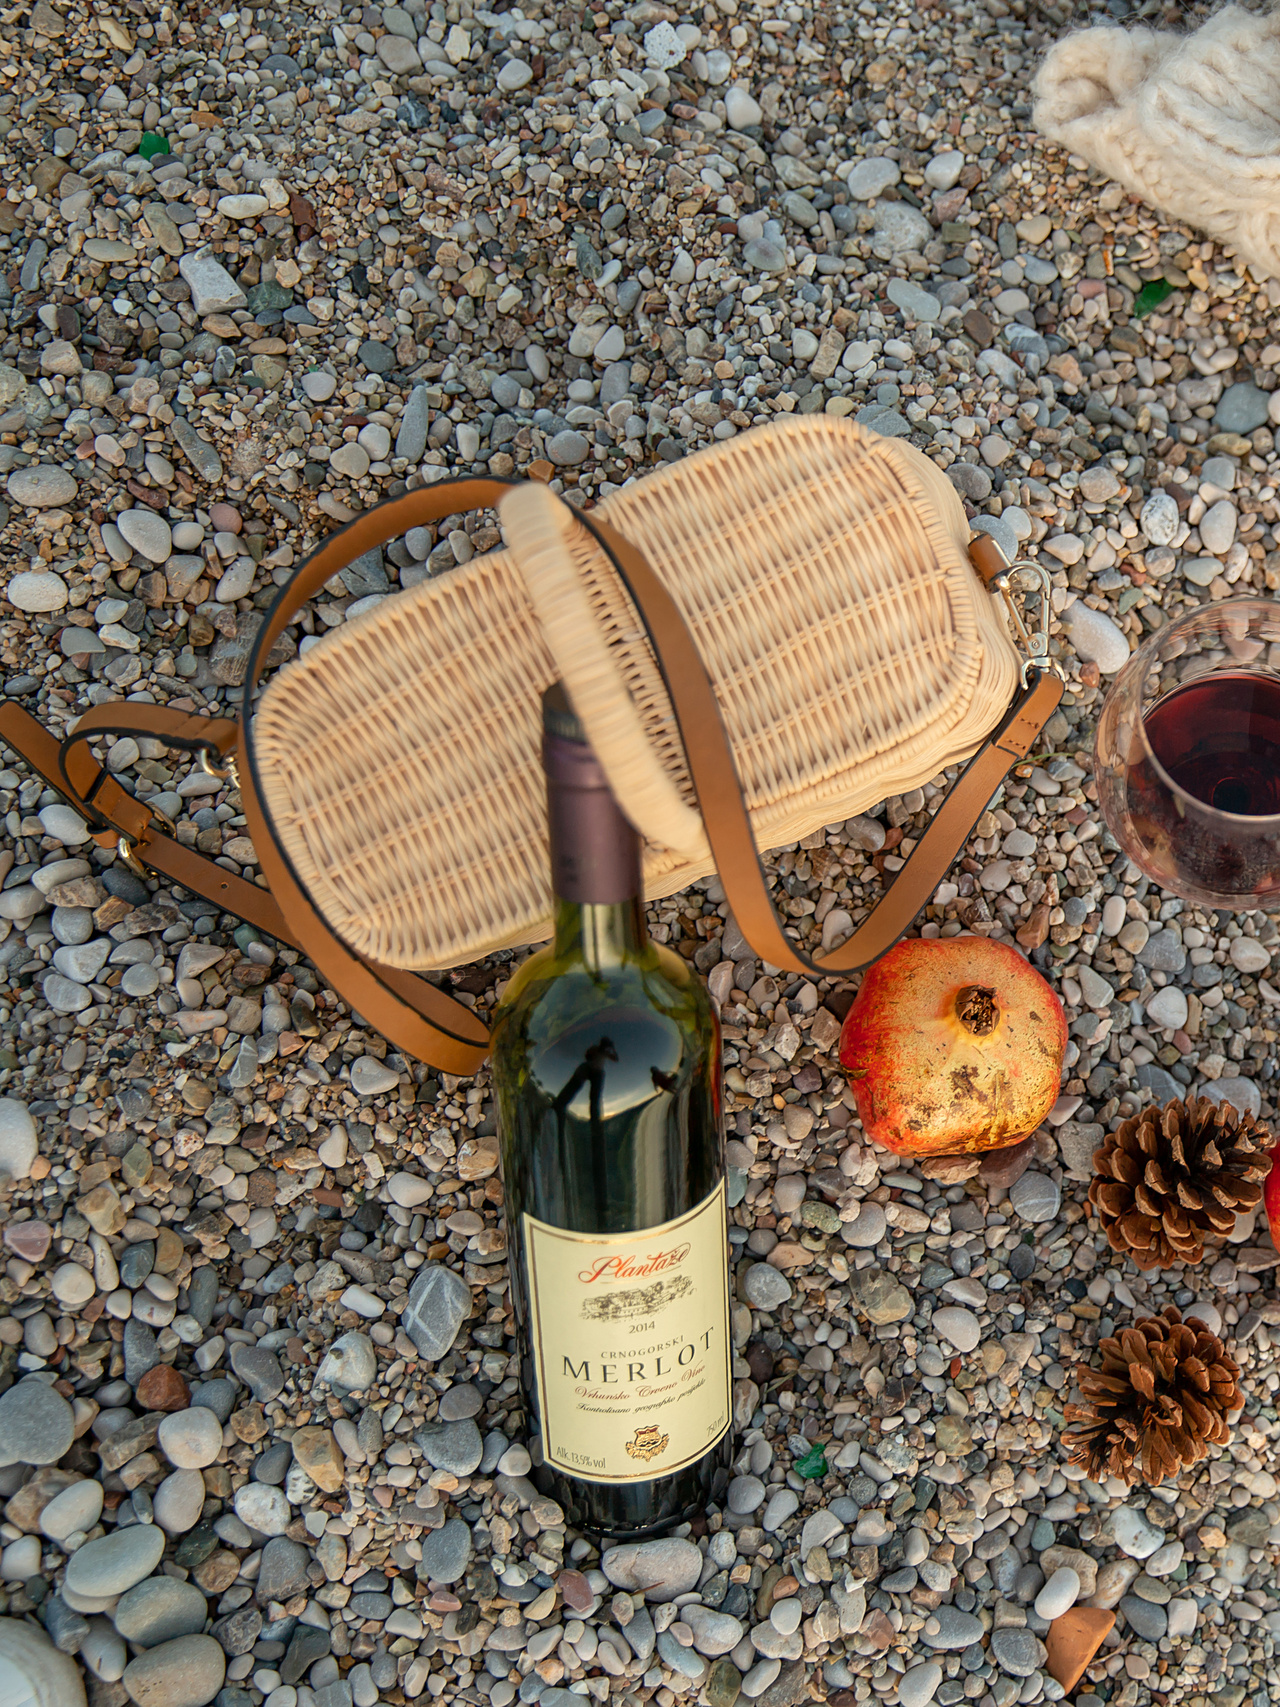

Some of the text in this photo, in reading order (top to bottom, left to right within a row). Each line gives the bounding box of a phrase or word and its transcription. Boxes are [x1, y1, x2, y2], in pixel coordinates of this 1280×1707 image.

[578, 1242, 691, 1283] Plantaže
[629, 1321, 656, 1334] 2014
[562, 1327, 714, 1383] MERLOT
[601, 1335, 685, 1359] CRNOGORSKI
[574, 1360, 706, 1400] Vrhunsko Crveno Vino
[576, 1403, 631, 1413] Kontrolisano
[556, 1446, 570, 1461] Alk.
[593, 1457, 606, 1469] vol
